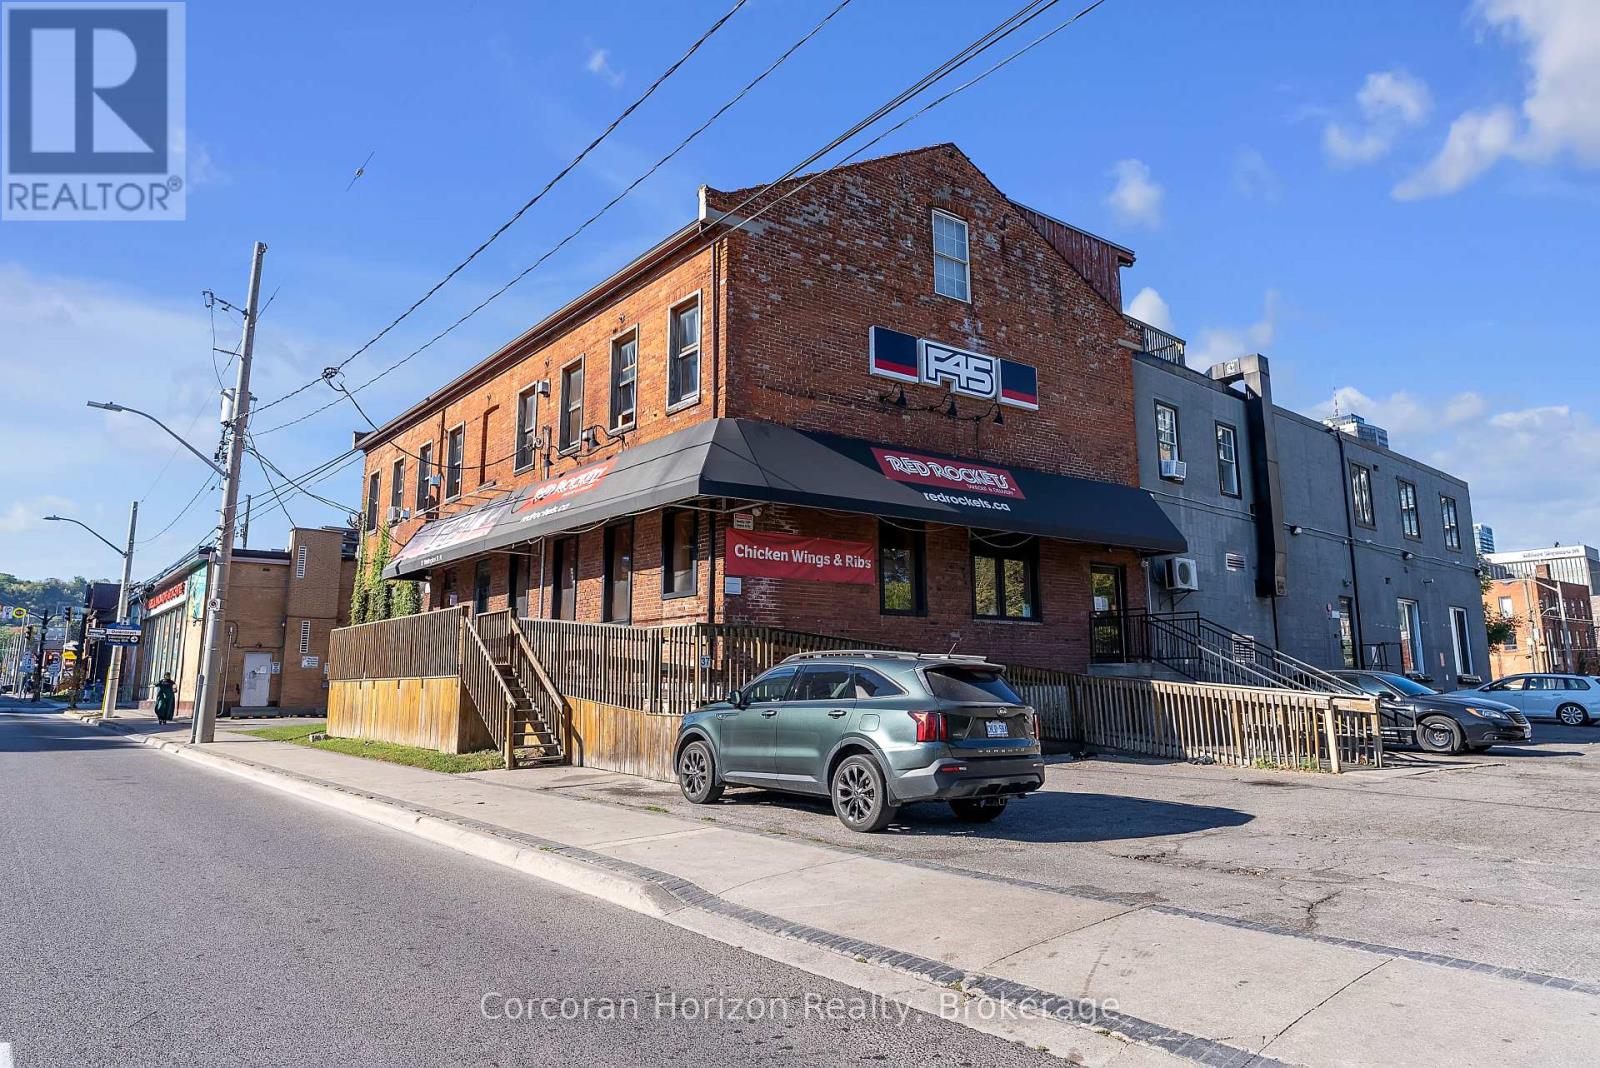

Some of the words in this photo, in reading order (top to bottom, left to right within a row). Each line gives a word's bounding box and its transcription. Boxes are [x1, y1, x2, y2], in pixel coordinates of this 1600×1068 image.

[925, 343, 994, 396] F45
[884, 455, 931, 477] RED
[926, 461, 1009, 489] ROCKETS
[923, 491, 1011, 512] redrockets.ca
[734, 543, 789, 562] Chicken
[791, 549, 831, 568] Wings
[833, 553, 843, 566] &
[845, 554, 872, 569] Ribs
[700, 656, 710, 666] 37
